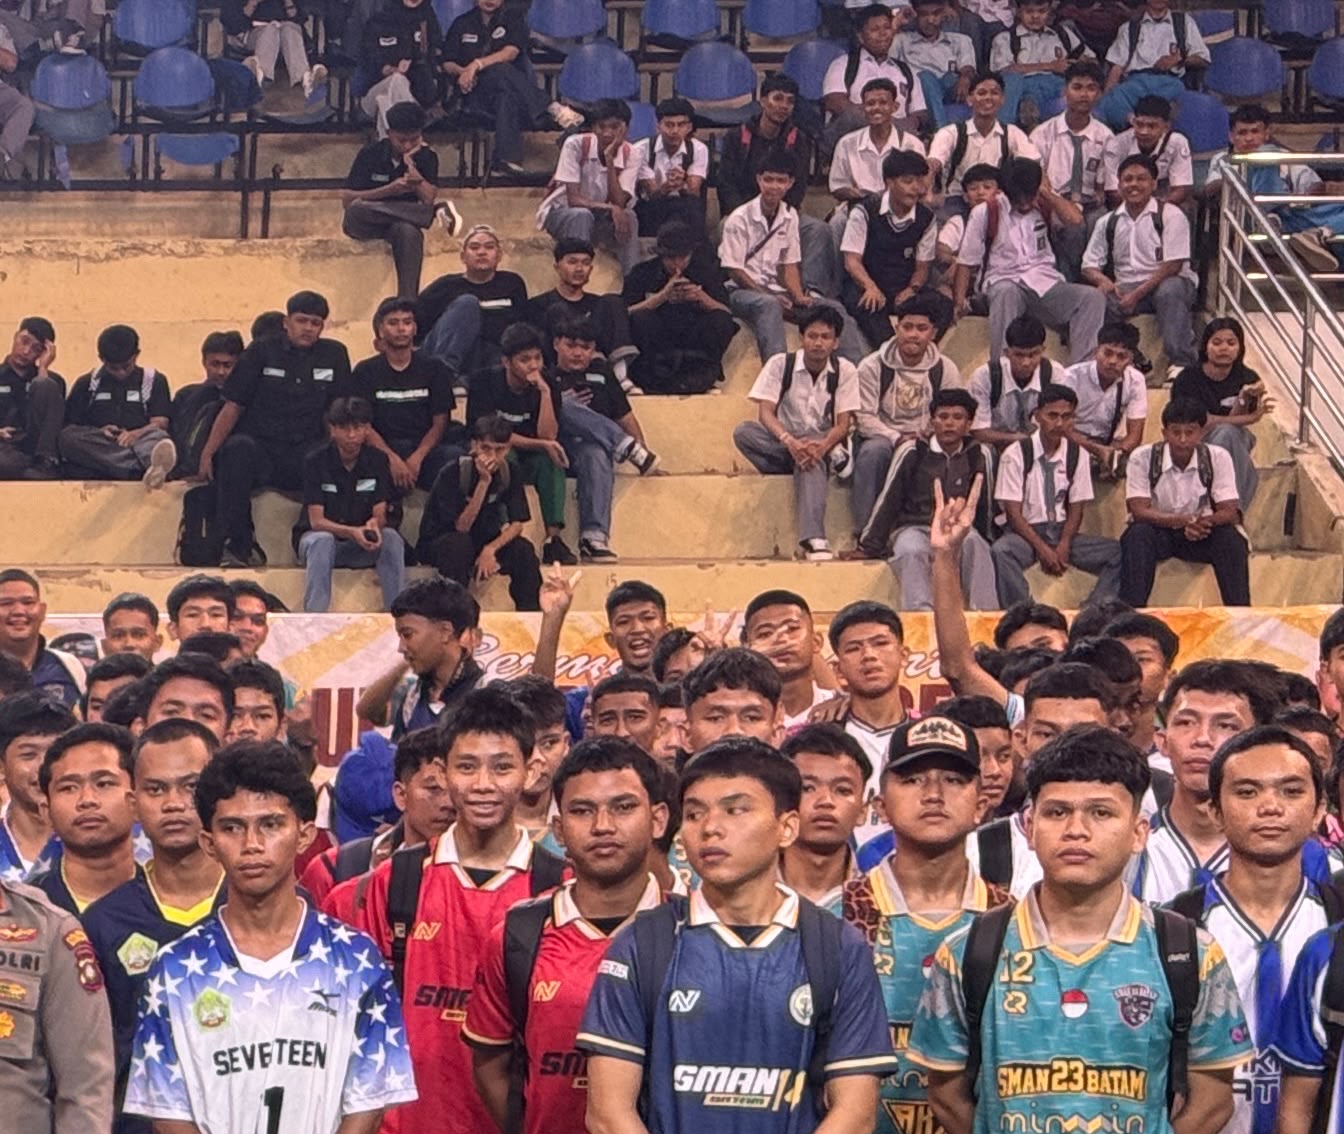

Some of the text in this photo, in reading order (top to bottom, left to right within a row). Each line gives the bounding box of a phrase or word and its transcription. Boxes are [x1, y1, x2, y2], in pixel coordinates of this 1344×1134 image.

[999, 950, 1035, 984] 12
[213, 1038, 328, 1076] SEVETEEN
[673, 1064, 780, 1095] SMAN
[997, 1057, 1147, 1101] SMAN 23 BATAM
